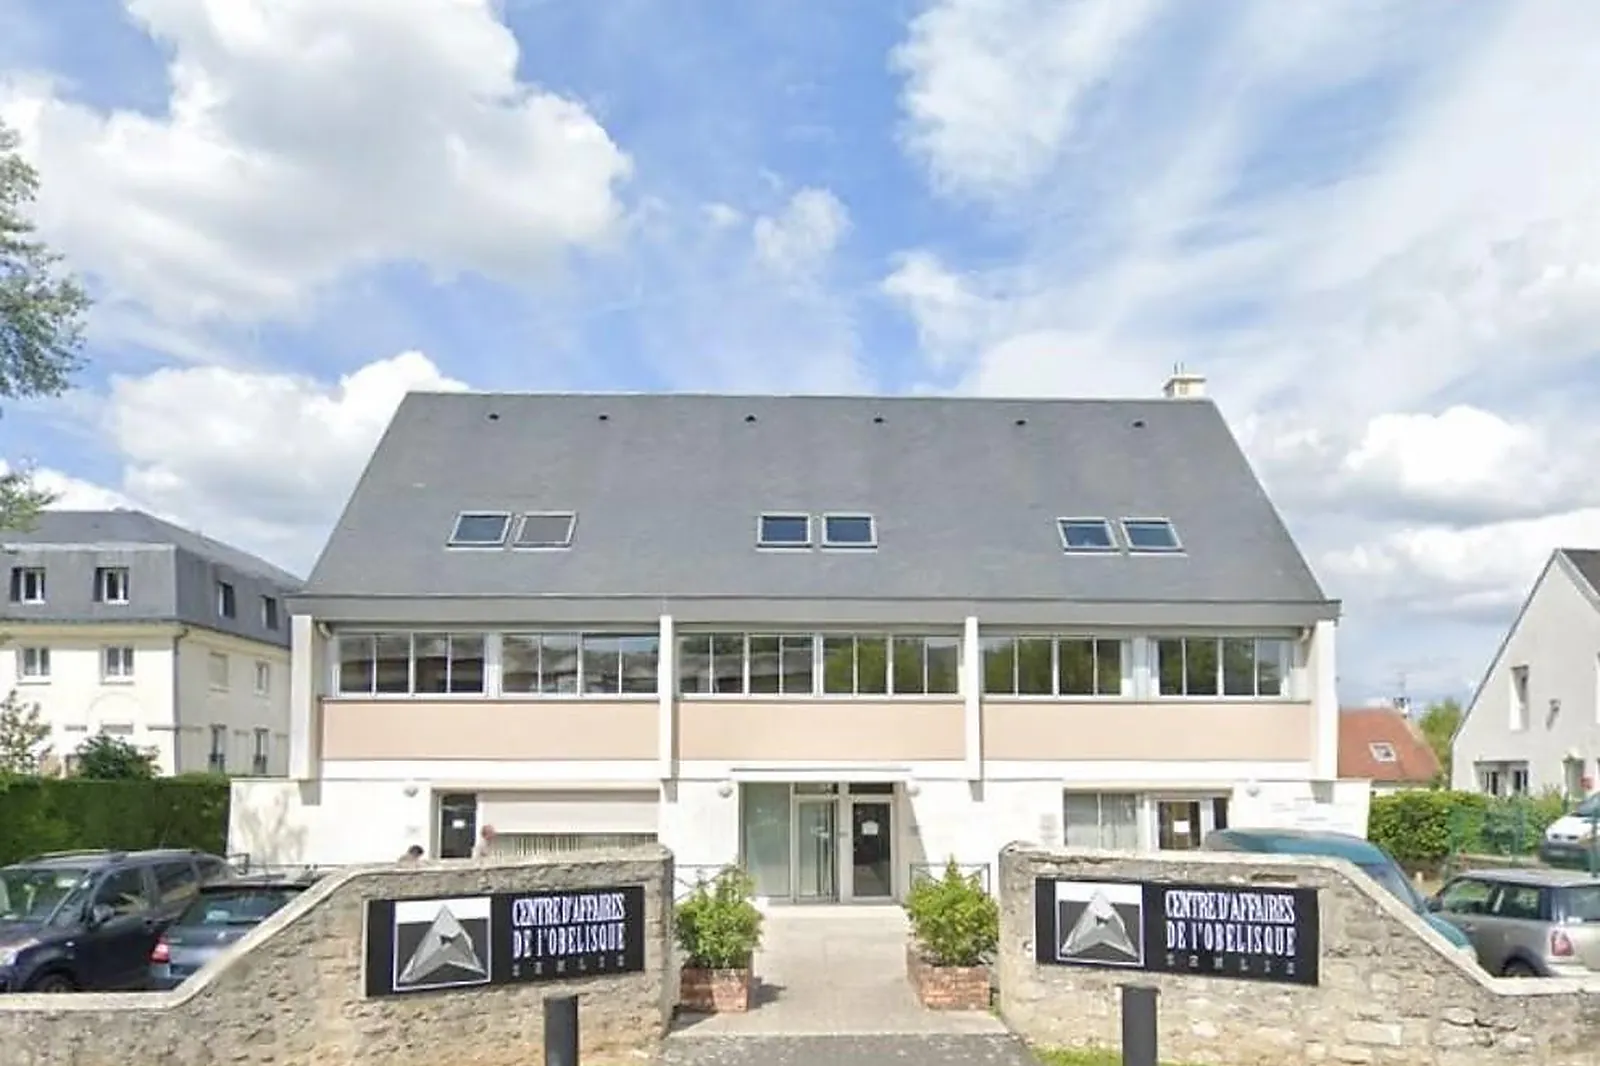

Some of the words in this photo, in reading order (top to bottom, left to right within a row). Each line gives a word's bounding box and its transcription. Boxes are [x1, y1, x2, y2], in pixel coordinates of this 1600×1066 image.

[512, 896, 561, 927] CENTRE
[562, 892, 625, 924] D'AFFAIRES
[1165, 889, 1217, 920] CENTRE
[1218, 892, 1295, 924] D'AFFAIRES
[513, 928, 533, 958] DE
[1166, 920, 1187, 950] DE
